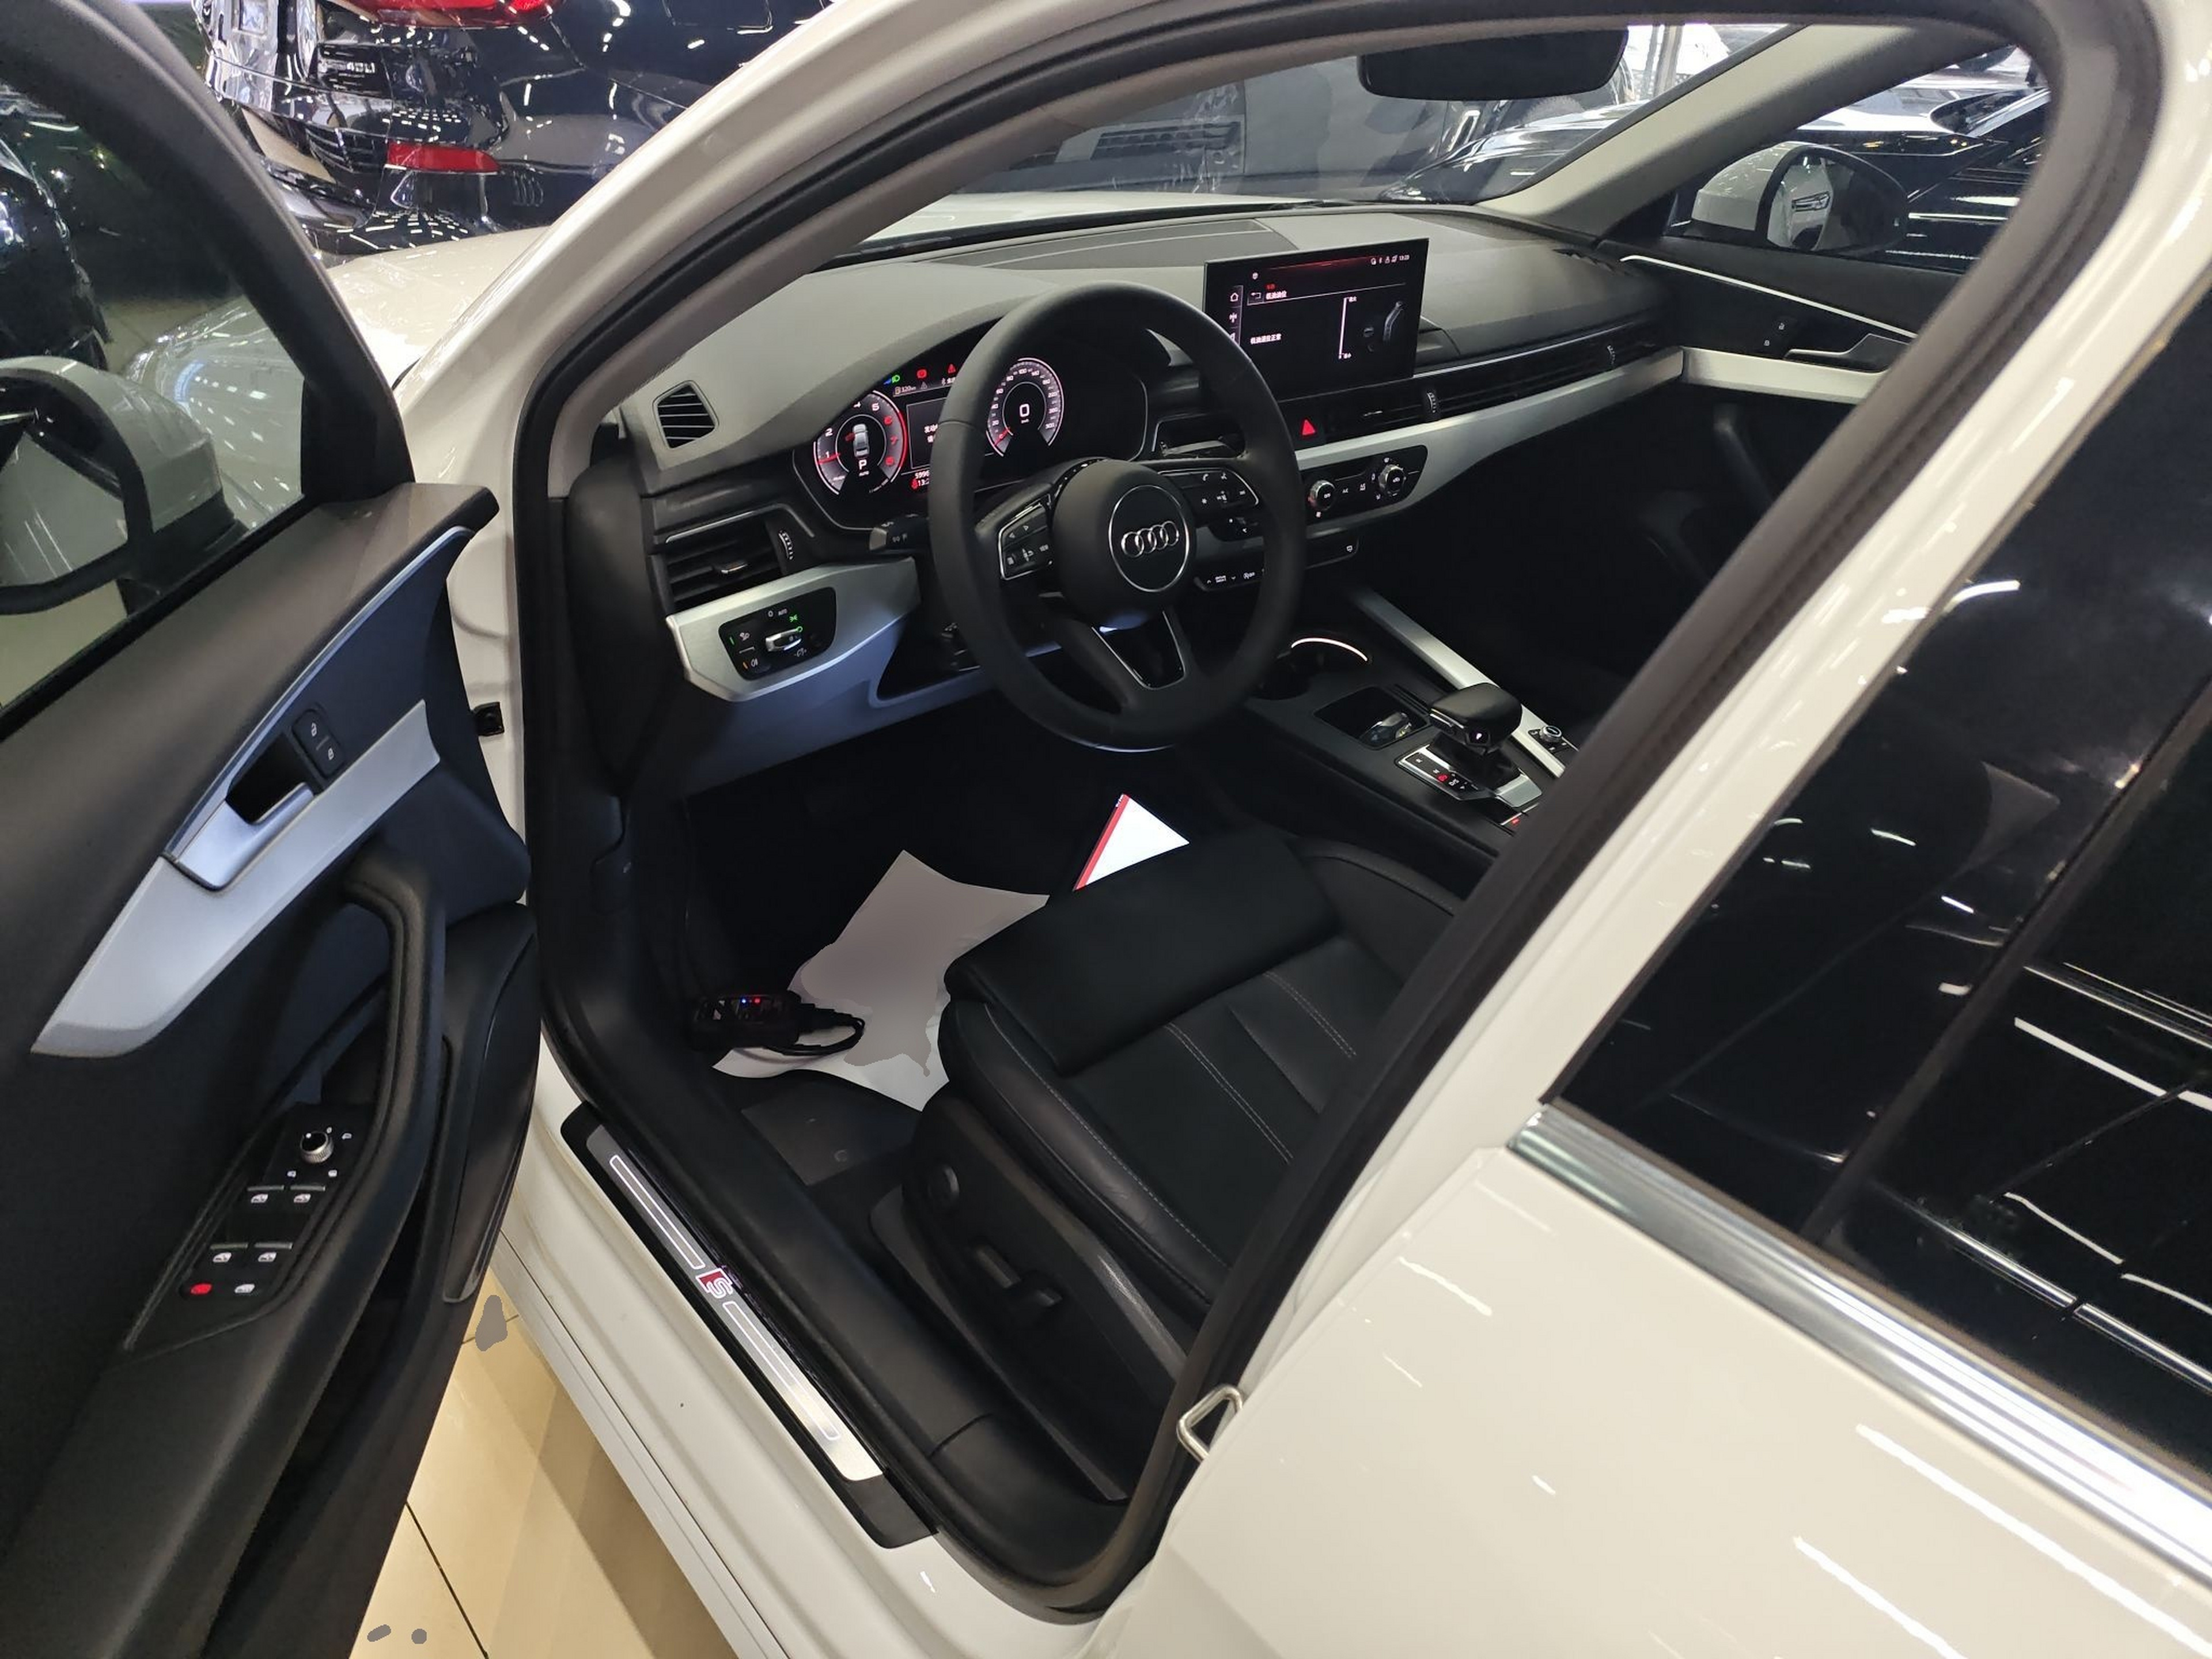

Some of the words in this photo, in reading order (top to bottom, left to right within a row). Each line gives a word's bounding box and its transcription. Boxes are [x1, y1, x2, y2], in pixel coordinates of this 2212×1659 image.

[872, 403, 880, 411] 5
[1020, 404, 1029, 418] 0
[825, 428, 833, 437] 2
[859, 460, 867, 470] P
